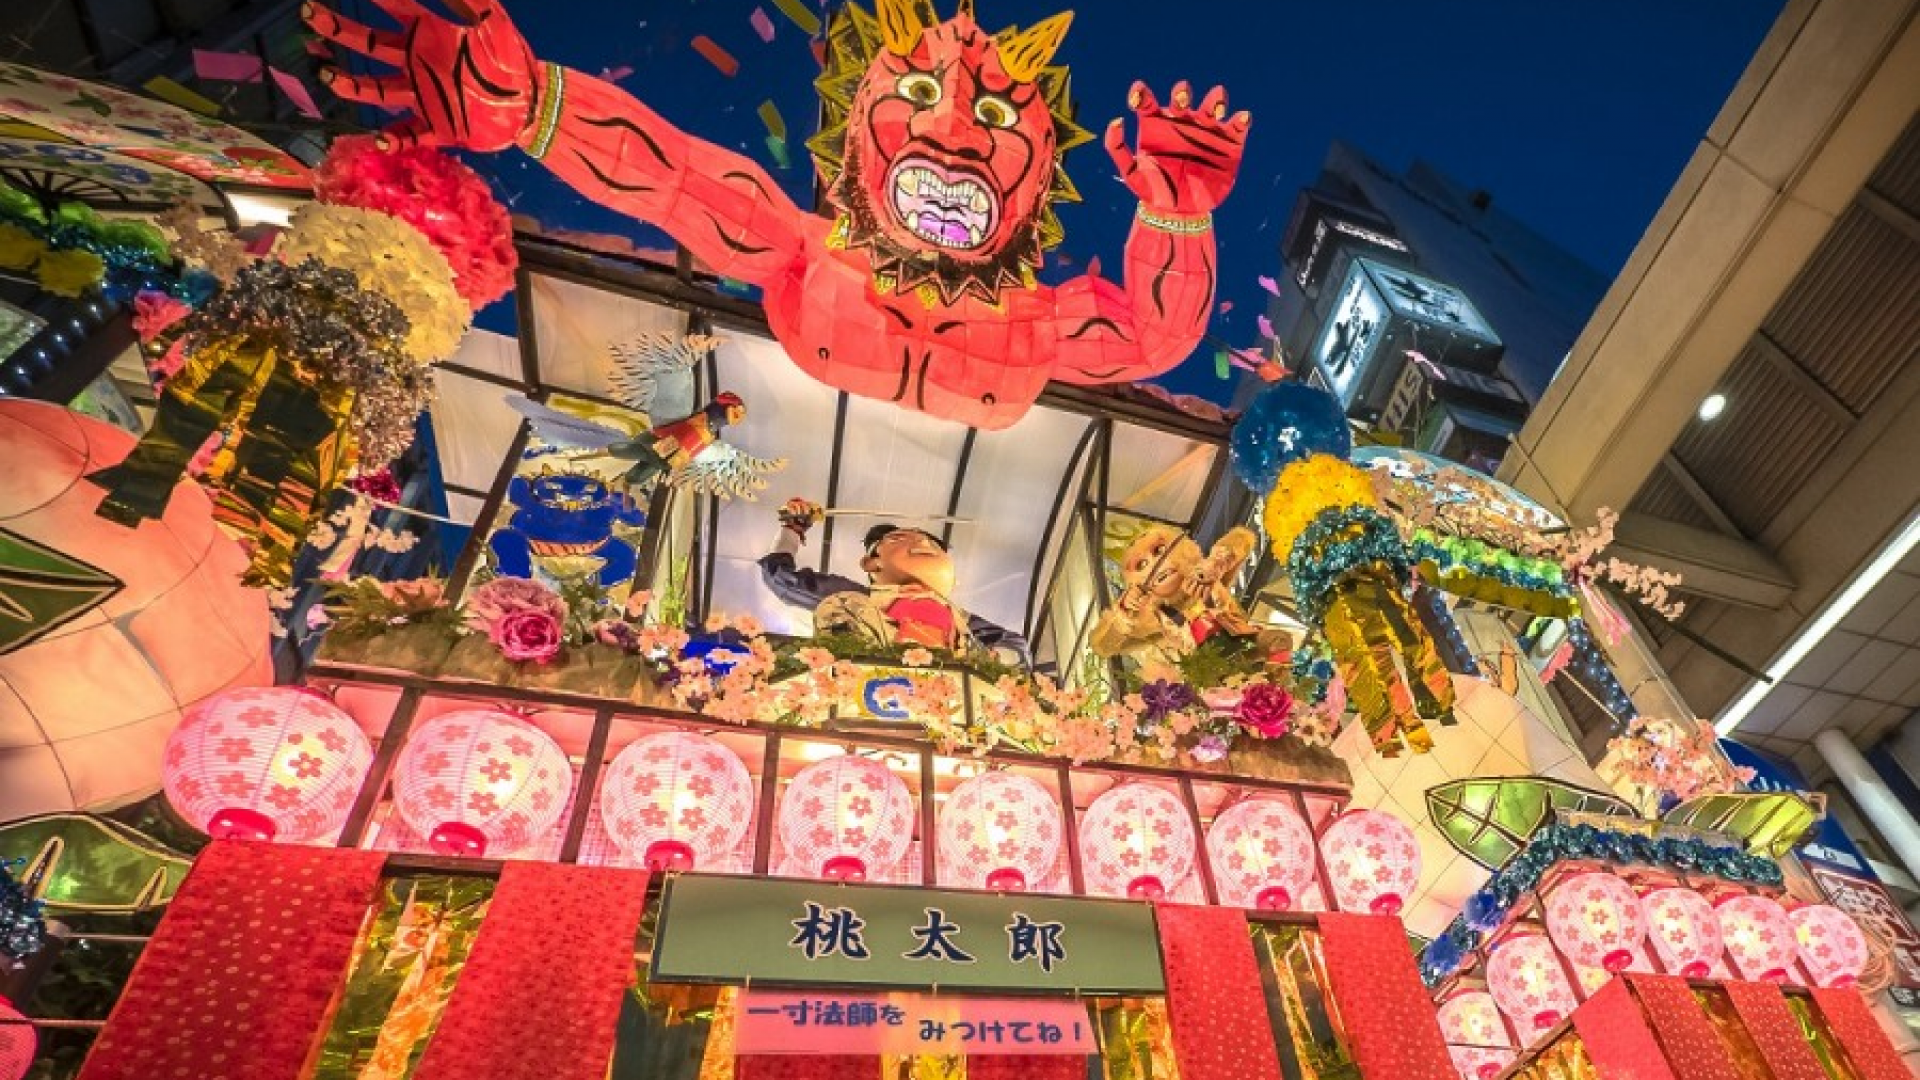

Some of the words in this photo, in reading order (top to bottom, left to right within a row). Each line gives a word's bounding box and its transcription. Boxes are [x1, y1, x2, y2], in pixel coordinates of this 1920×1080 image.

[790, 901, 1066, 972] 桃太郎
[747, 1001, 905, 1027] 一寸法師を
